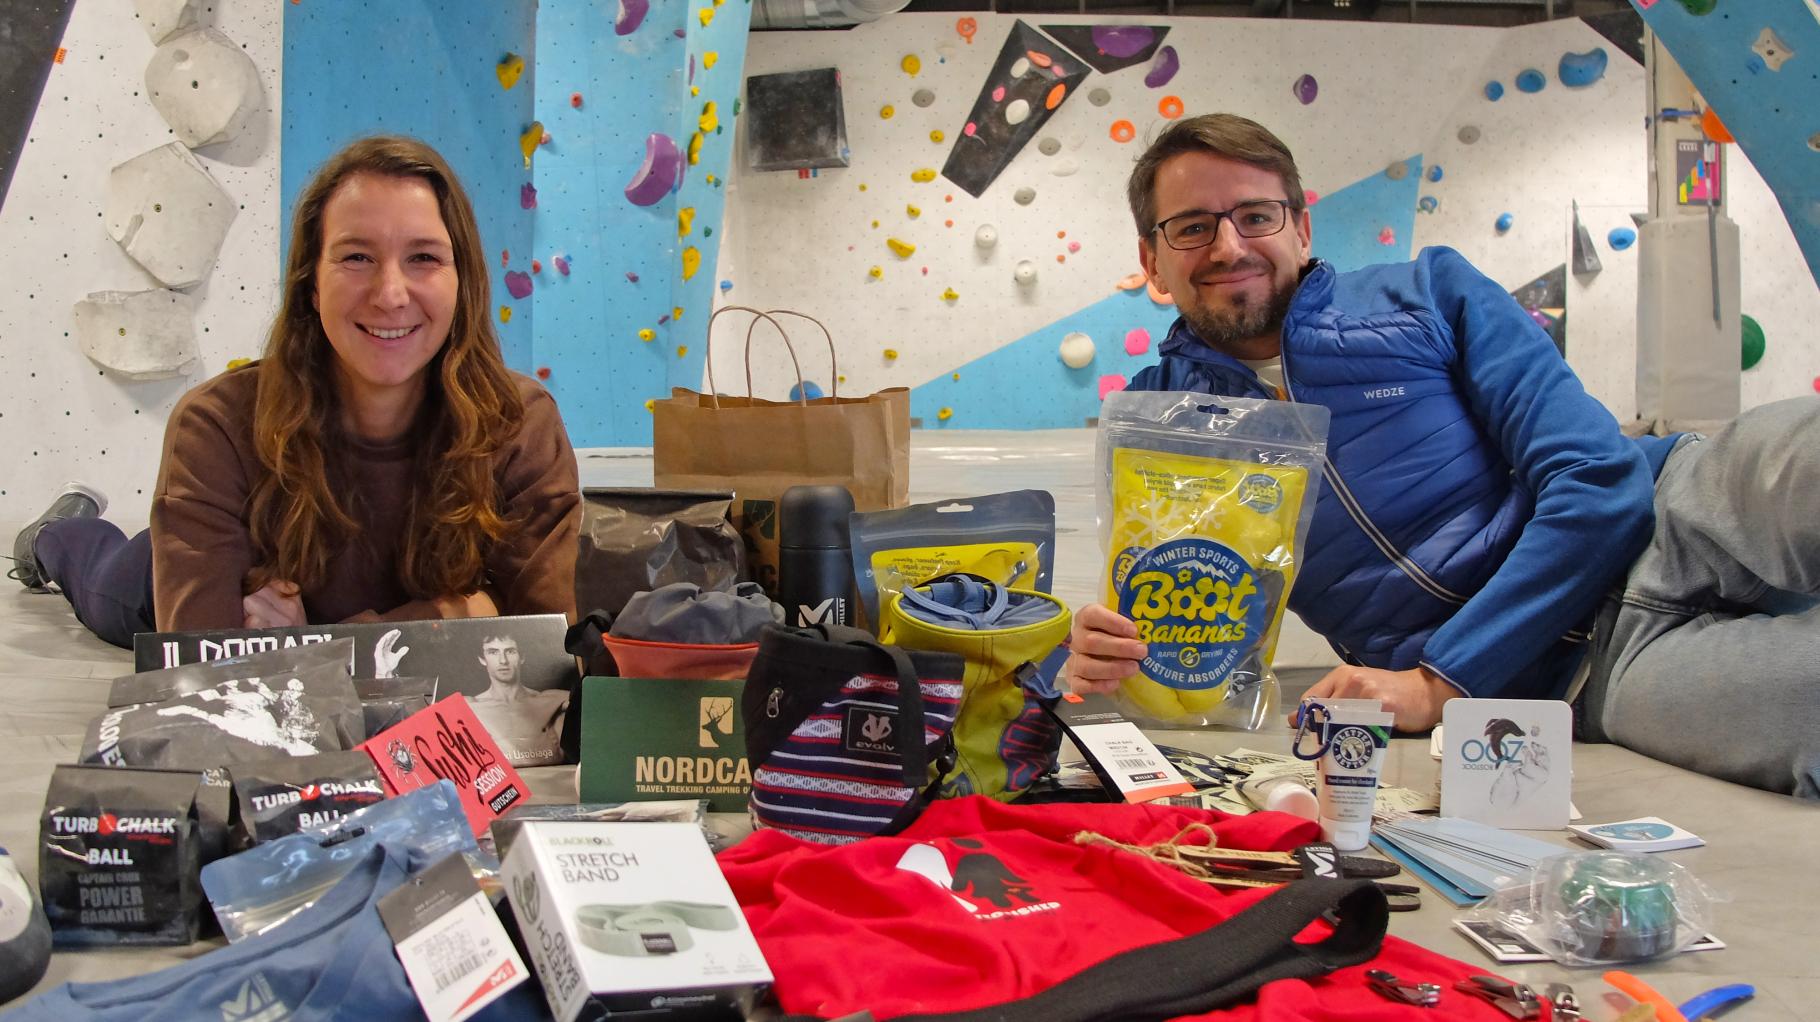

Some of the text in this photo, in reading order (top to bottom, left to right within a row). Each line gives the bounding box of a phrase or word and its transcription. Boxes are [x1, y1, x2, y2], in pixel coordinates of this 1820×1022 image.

[1363, 386, 1406, 400] WEDZE
[1153, 546, 1240, 575] WINTER SPORTS
[1130, 570, 1257, 622] Boot
[1135, 619, 1247, 644] Bananas
[1142, 648, 1239, 684] OISTURE ABSORBERS
[855, 741, 895, 751] evolv
[1334, 729, 1373, 747] KLETTER
[1335, 752, 1372, 769] RETTER
[474, 765, 507, 796] SESSION
[636, 785, 665, 793] TRAVEL
[666, 785, 704, 794] TREKKING
[705, 785, 740, 794] CAMPING
[490, 786, 520, 812] GUTSCHEIN
[88, 848, 134, 865] BALL
[555, 852, 639, 867] STRETCH
[562, 867, 621, 884] BAND
[80, 885, 144, 908] POWER
[537, 919, 577, 1002] STRETCH
[554, 931, 581, 990] BAND
